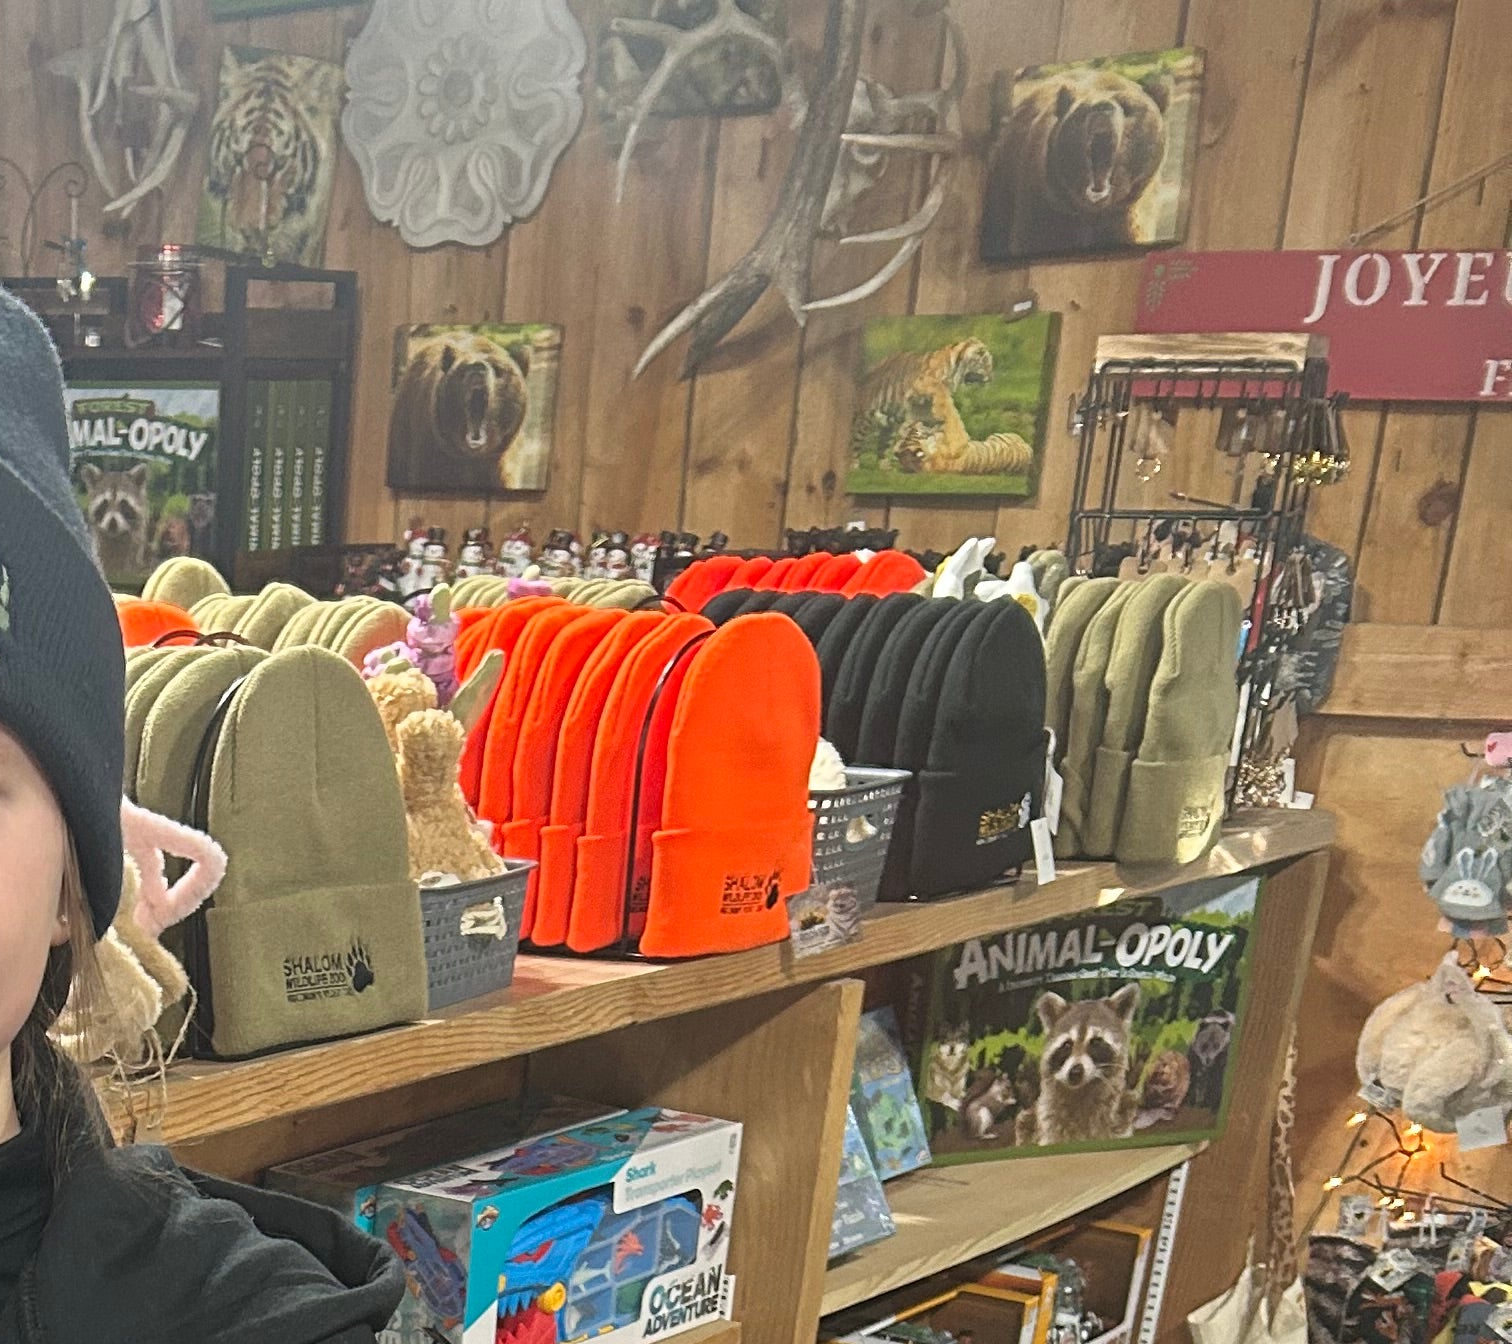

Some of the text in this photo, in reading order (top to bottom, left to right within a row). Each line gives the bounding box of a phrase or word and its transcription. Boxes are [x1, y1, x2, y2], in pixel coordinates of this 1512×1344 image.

[1303, 251, 1512, 324] JOYE
[1479, 358, 1512, 396] F
[70, 417, 208, 461] MAL-OPOLY
[283, 952, 345, 977] SHALOM
[953, 922, 1235, 990] ANIMAL-OPOLY
[649, 1264, 723, 1316] OCEAN
[642, 1293, 719, 1339] ADVENTURE
